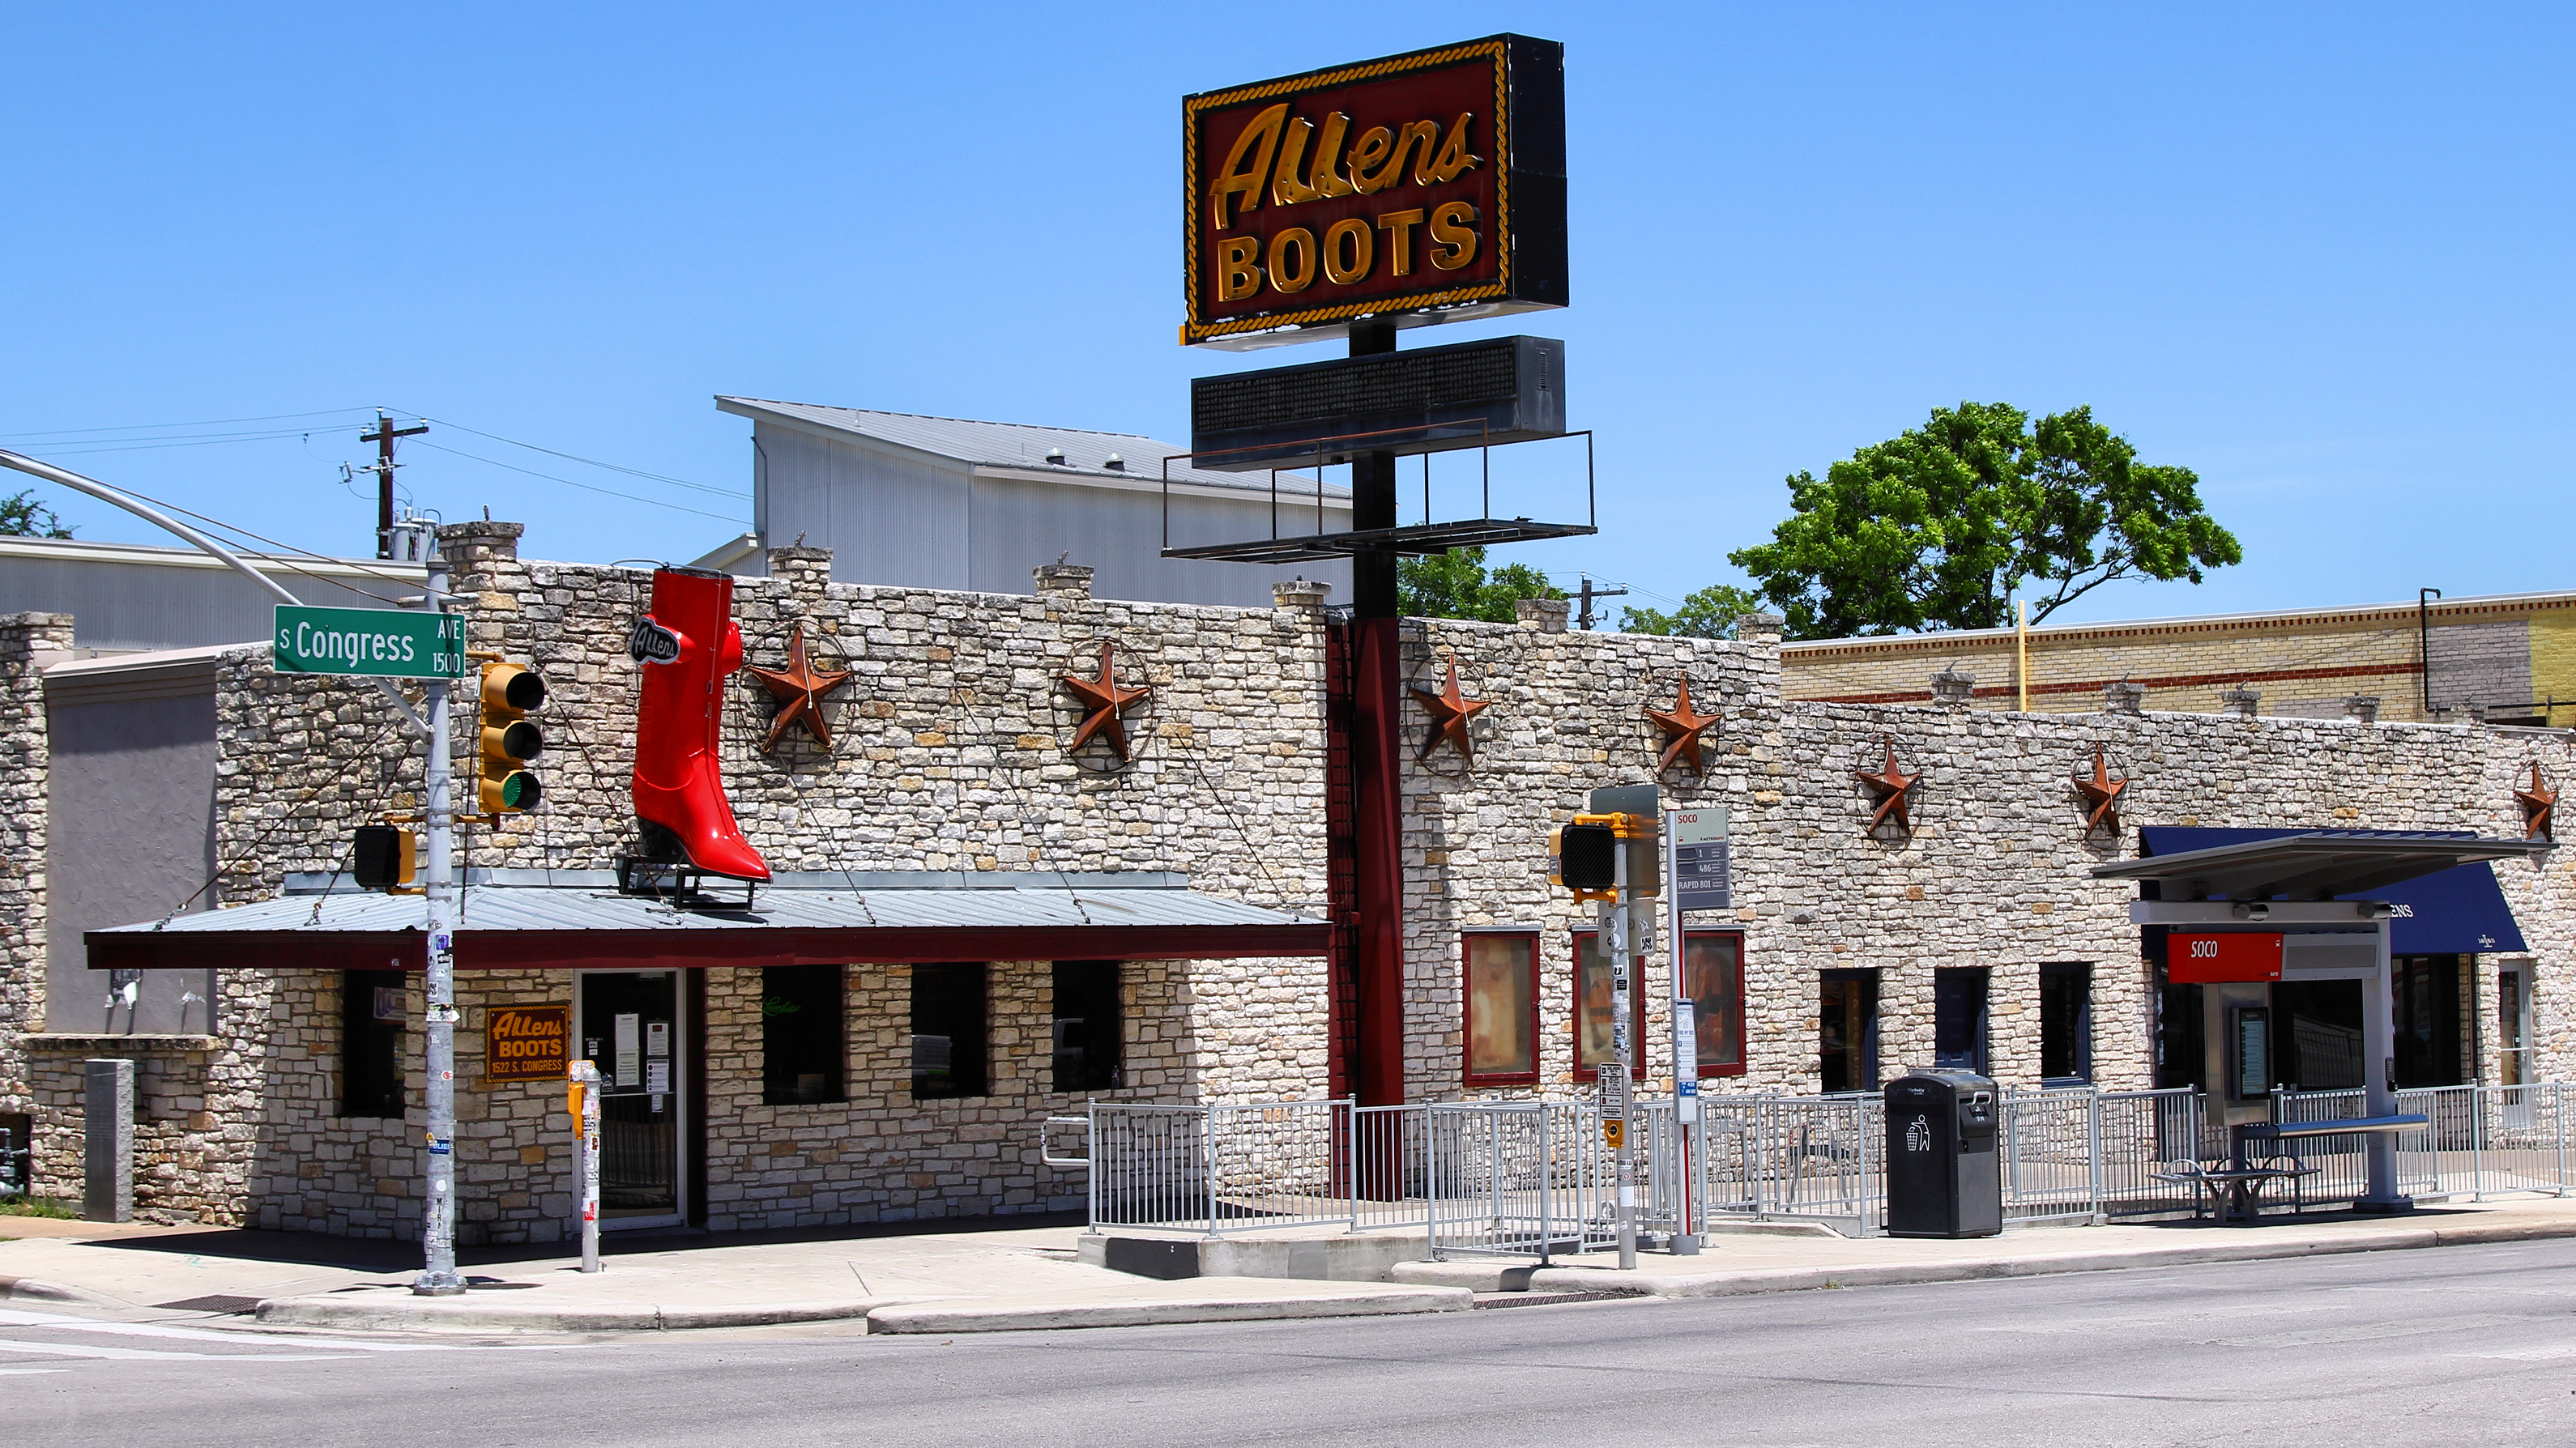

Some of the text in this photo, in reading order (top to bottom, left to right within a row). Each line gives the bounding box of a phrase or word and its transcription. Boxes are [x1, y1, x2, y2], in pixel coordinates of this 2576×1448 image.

[1209, 103, 1484, 230] Allens
[1218, 201, 1481, 302] BOOTS
[437, 619, 461, 640] AVE
[279, 621, 415, 669] S Congress
[634, 626, 675, 657] Allens
[433, 652, 461, 674] 1500
[1678, 814, 1698, 824] SOCO
[1699, 850, 1703, 858] 1
[1699, 864, 1712, 873] 486
[1678, 880, 1699, 890] RAPID
[1700, 879, 1711, 888] 801
[2190, 940, 2218, 958] SOCO
[493, 1011, 563, 1040] Allens
[499, 1038, 562, 1058] BOOTS
[492, 1059, 562, 1074] 1522 S. CONGRESS
